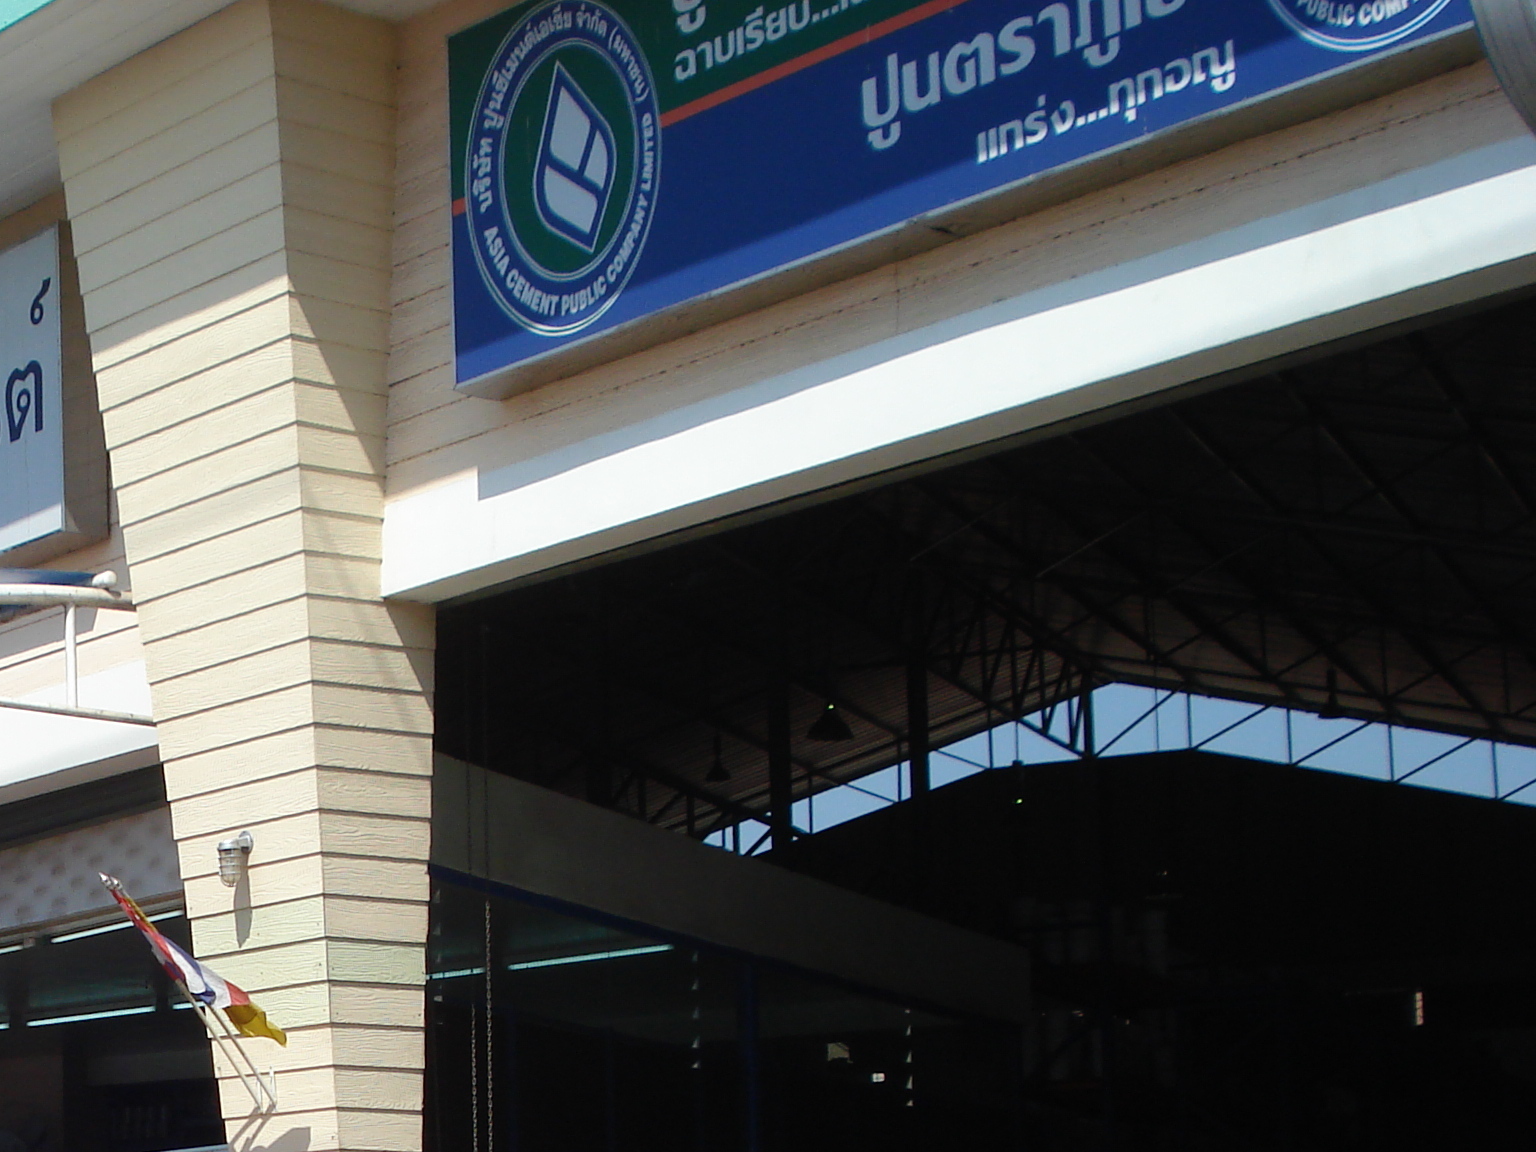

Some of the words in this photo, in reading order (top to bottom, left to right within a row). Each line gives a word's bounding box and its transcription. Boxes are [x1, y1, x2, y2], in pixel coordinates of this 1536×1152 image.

[484, 226, 508, 276] ASIA
[505, 266, 560, 318] CEMENT
[561, 275, 608, 318] PUBLIC
[606, 197, 649, 284] COMPANY
[641, 111, 656, 194] LIMITED
